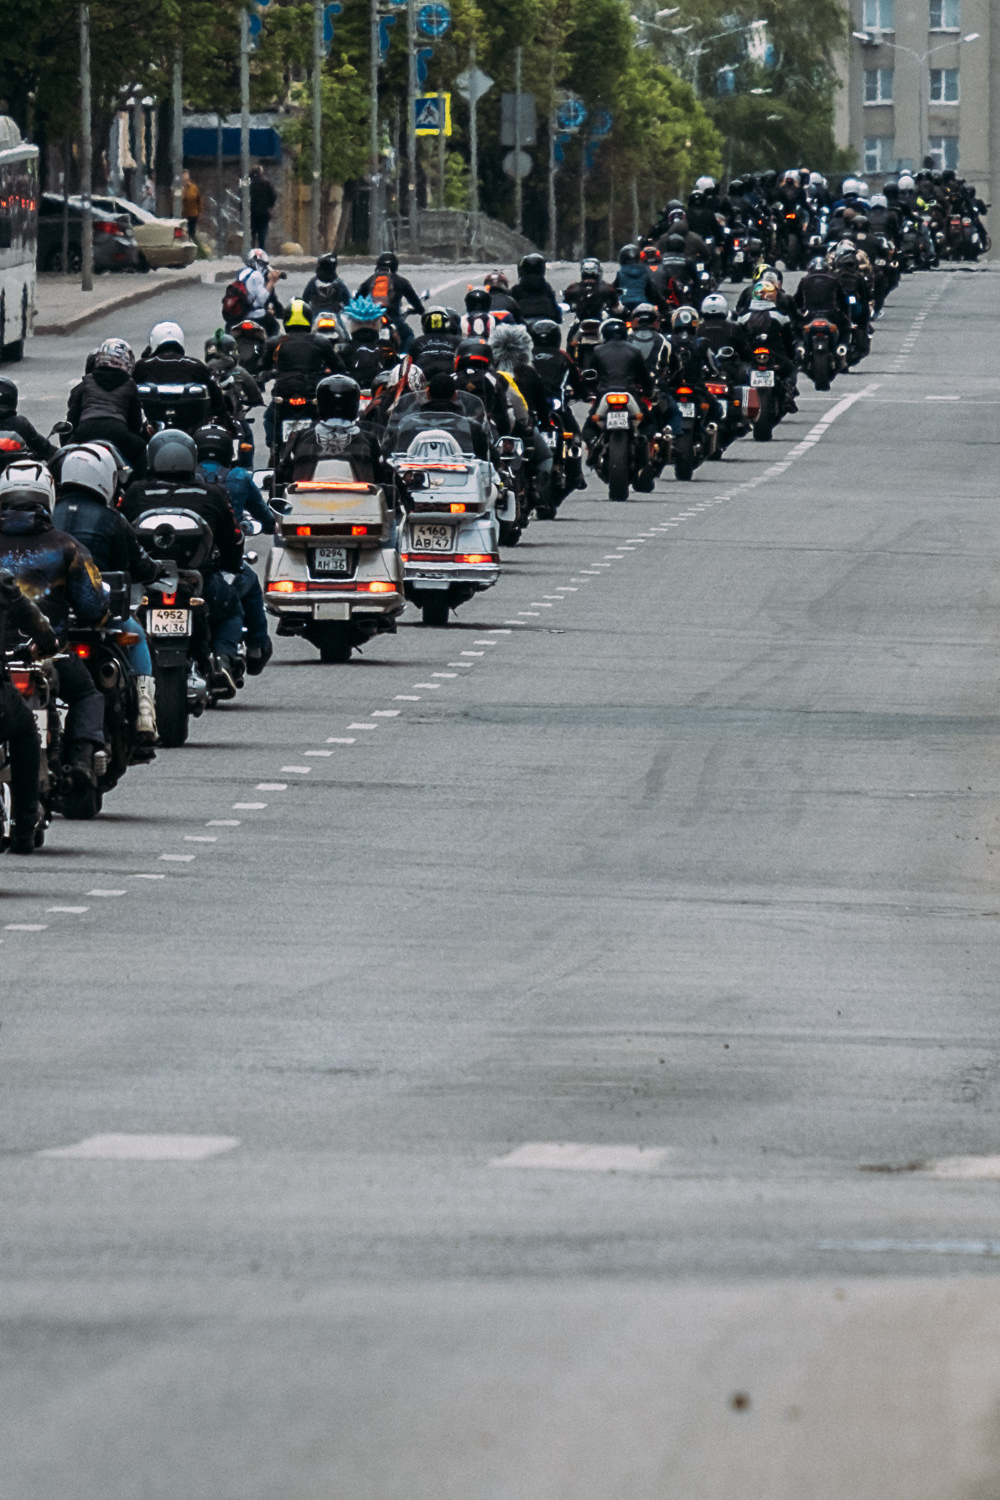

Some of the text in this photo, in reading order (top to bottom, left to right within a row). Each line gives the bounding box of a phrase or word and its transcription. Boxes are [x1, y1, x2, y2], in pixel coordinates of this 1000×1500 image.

[419, 526, 447, 536] 4160
[435, 539, 449, 548] 47
[319, 550, 343, 558] 0294
[334, 561, 345, 570] 36
[157, 611, 183, 620] 4952
[173, 623, 185, 632] 36
